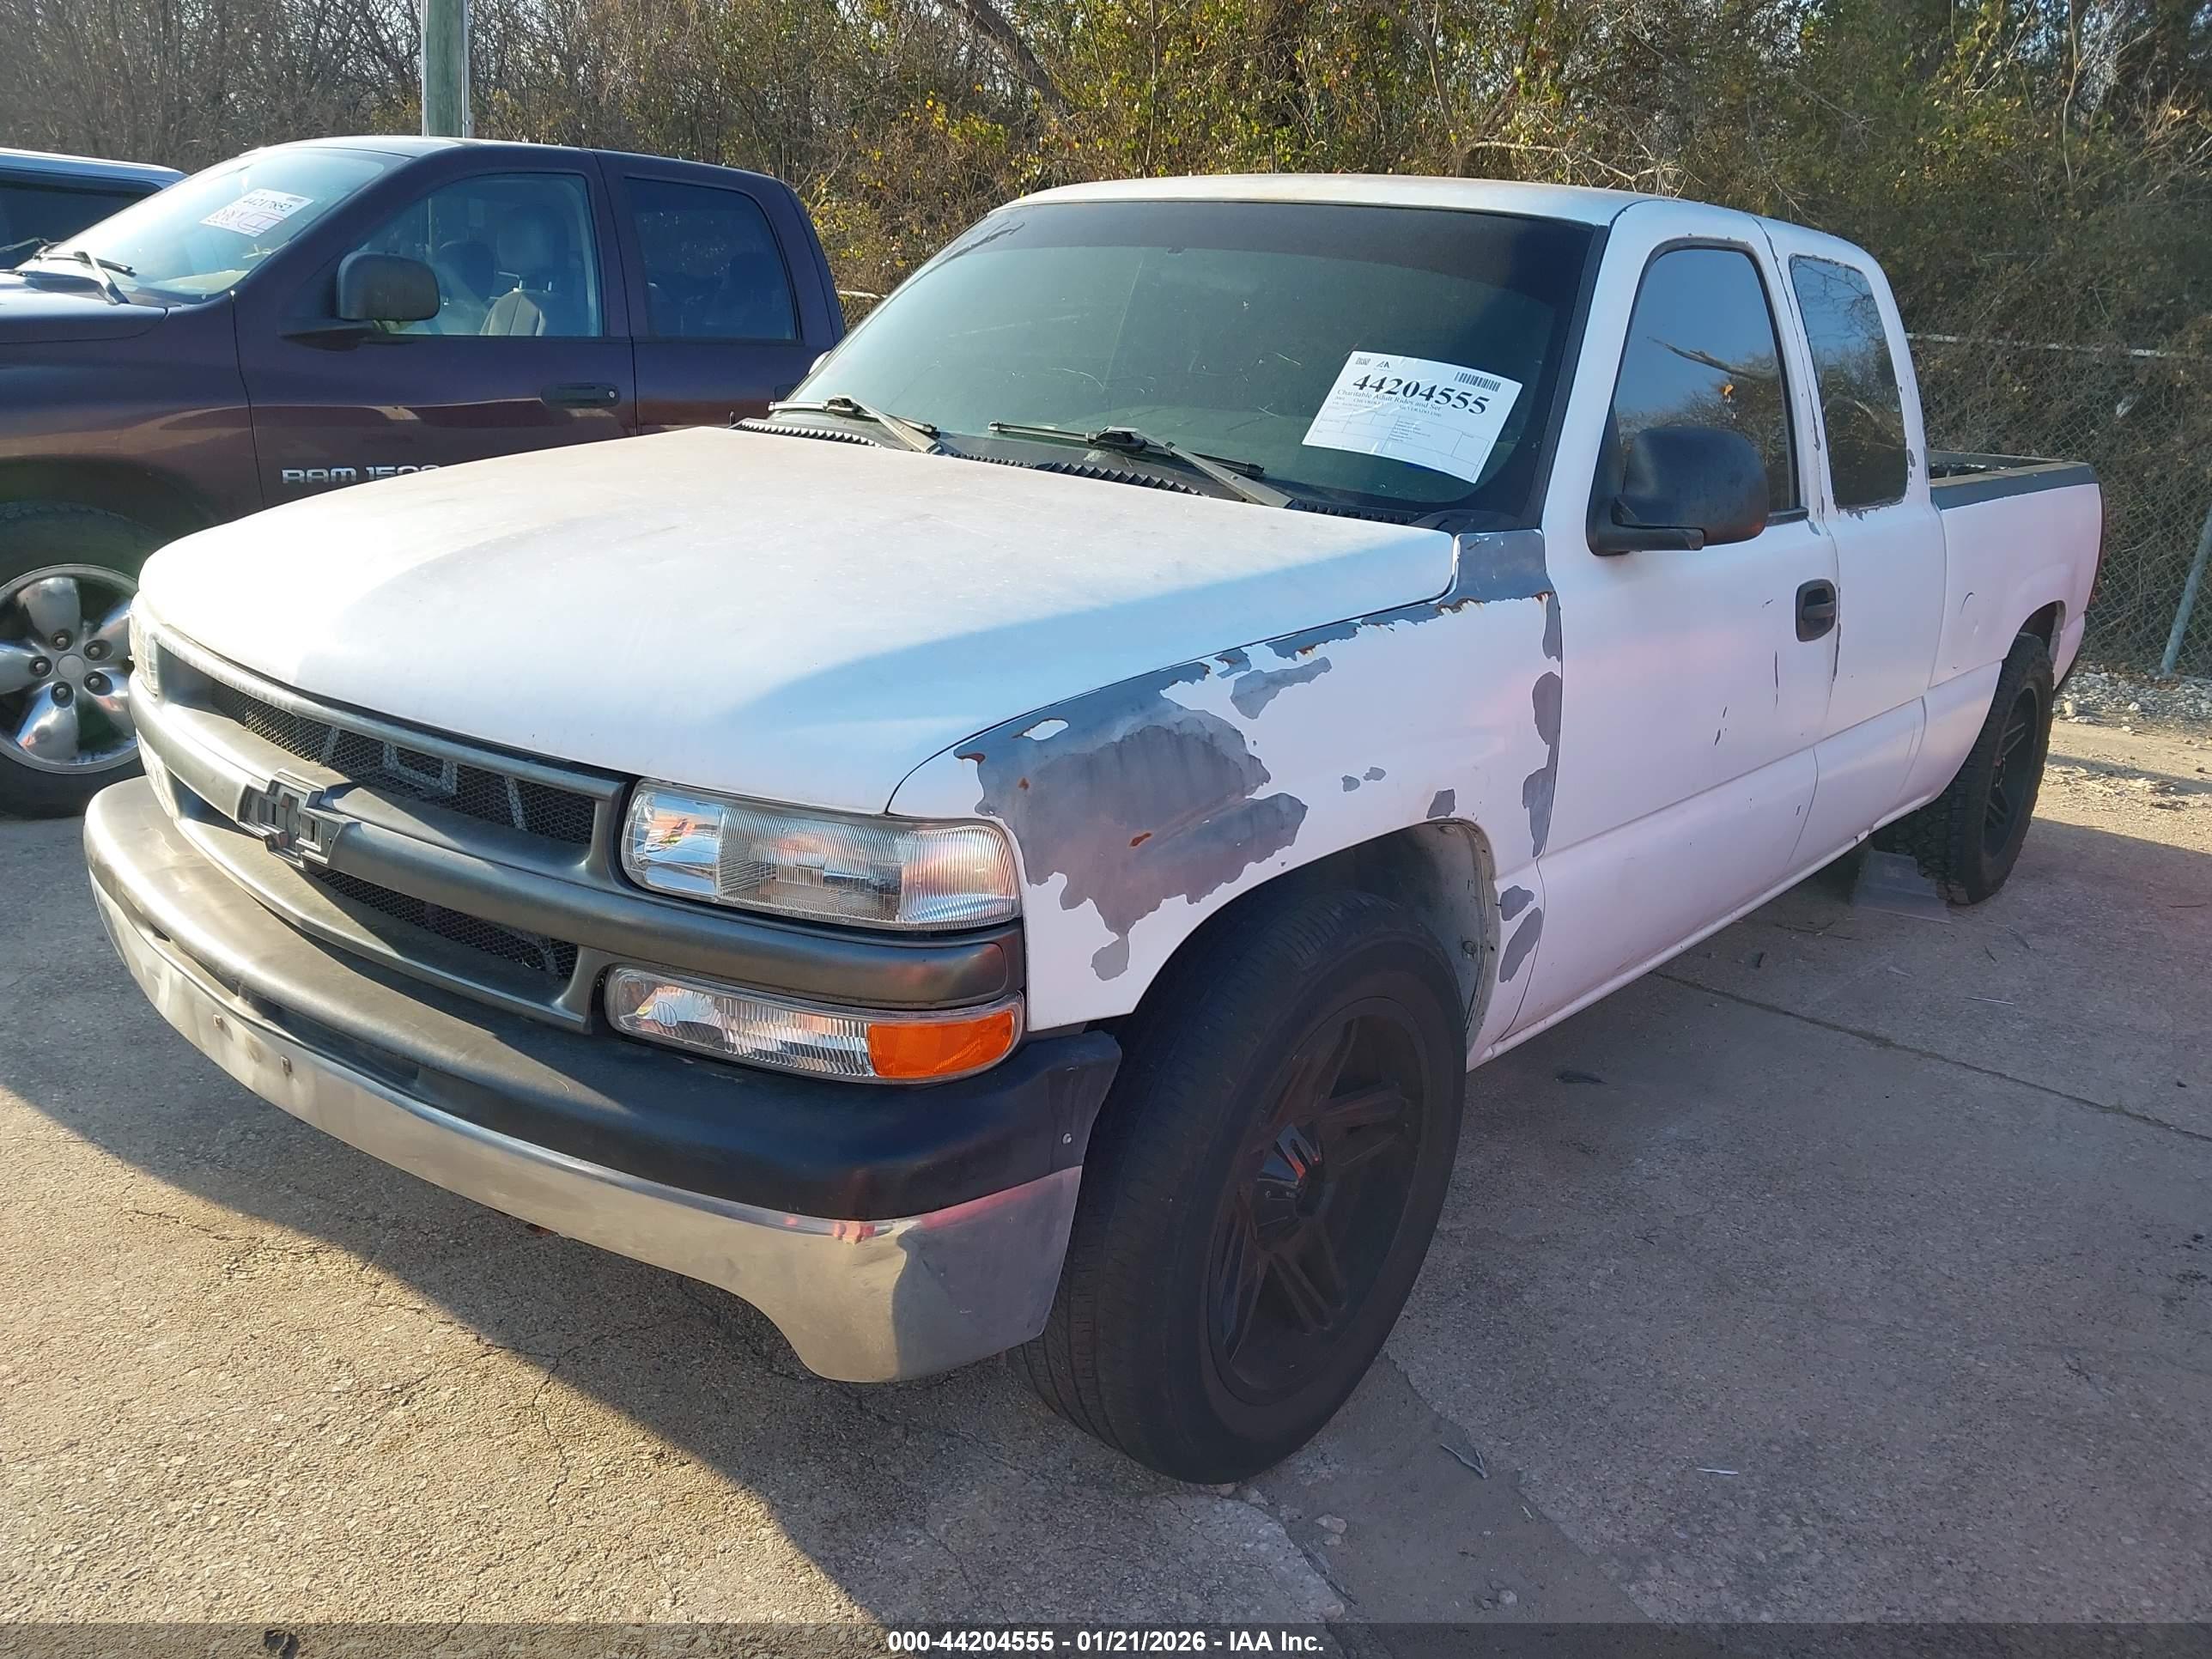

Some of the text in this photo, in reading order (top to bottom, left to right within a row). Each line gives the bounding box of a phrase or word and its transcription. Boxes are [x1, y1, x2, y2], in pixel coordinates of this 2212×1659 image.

[1337, 388, 1372, 398] Charitable
[1374, 392, 1393, 402] Adult
[1394, 396, 1413, 405] Rides
[1352, 374, 1491, 416] 44204555
[282, 467, 356, 483] RAM
